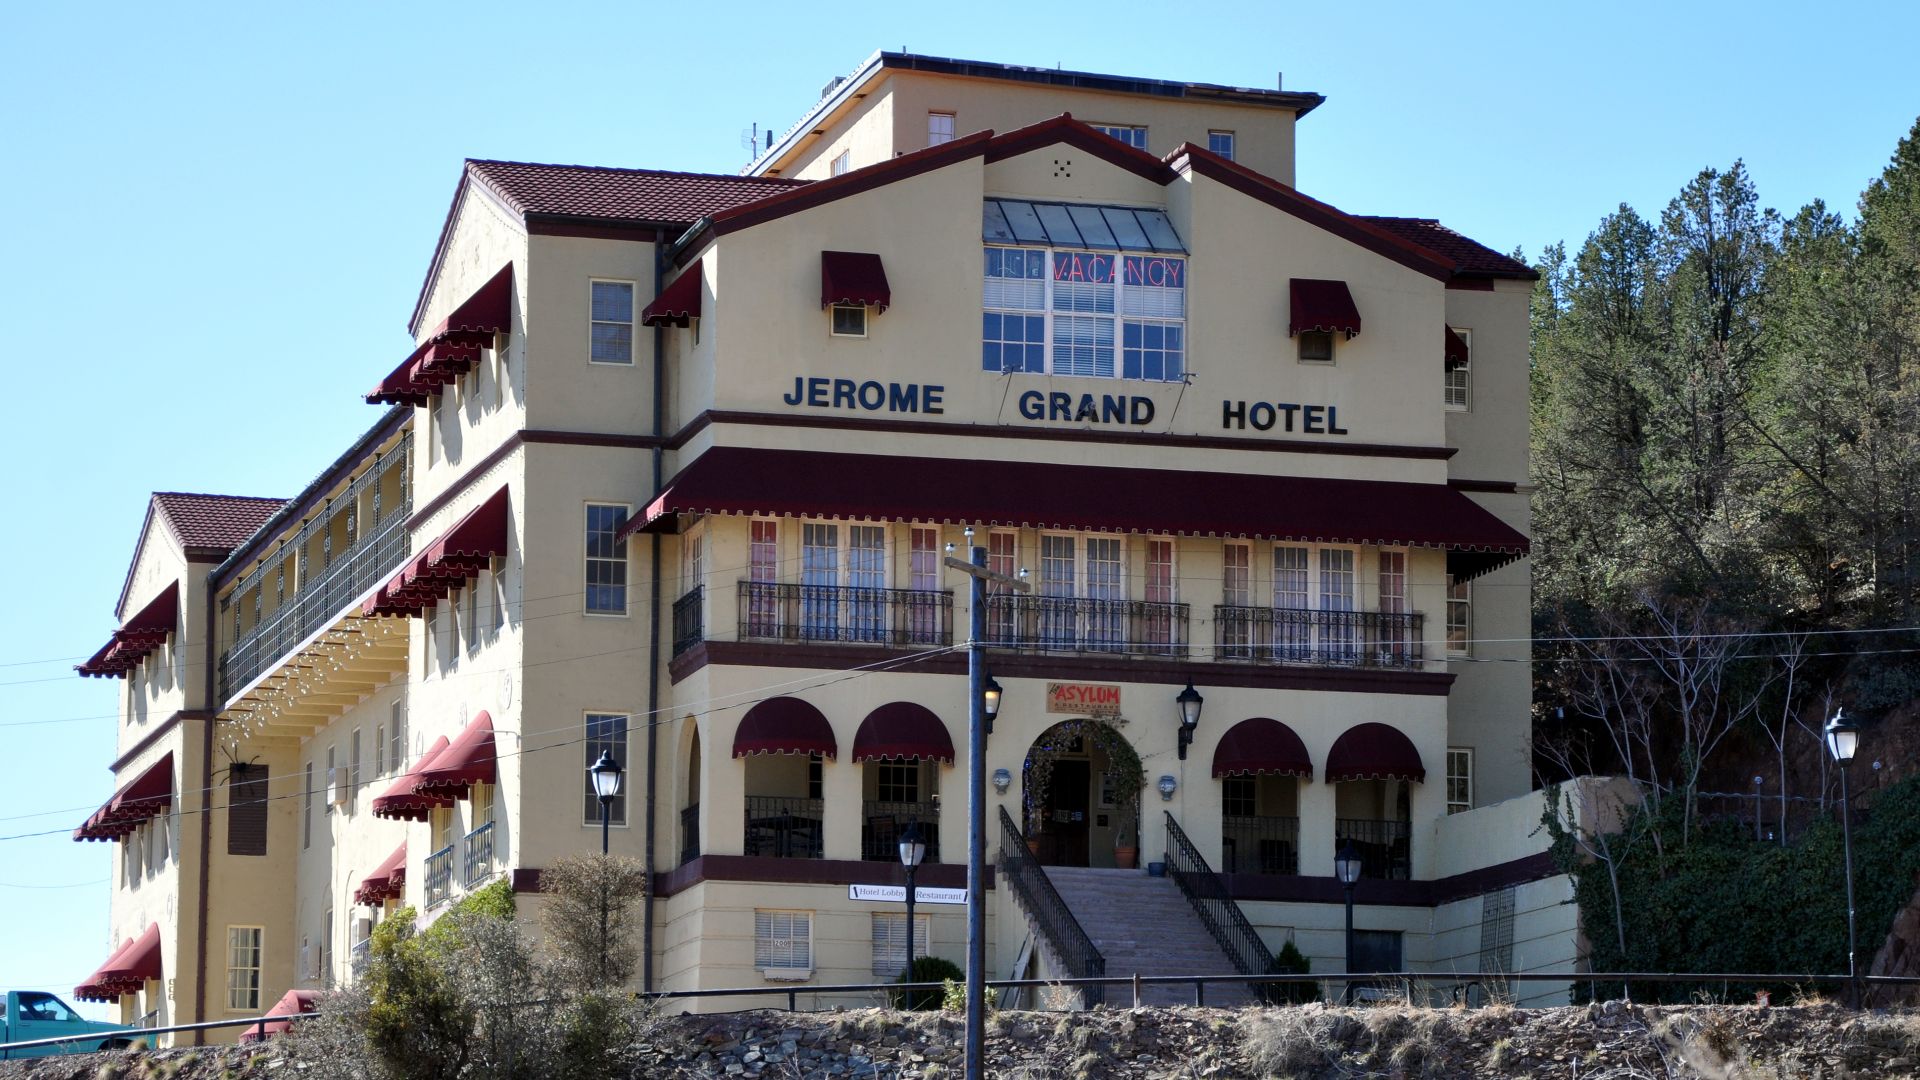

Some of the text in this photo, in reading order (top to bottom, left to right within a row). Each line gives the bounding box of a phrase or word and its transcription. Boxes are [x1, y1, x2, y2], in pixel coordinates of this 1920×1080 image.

[1052, 255, 1180, 286] VACANCY
[783, 376, 1348, 436] JEROME GRAND HOTEL
[1055, 685, 1119, 705] ASYLUM
[859, 888, 962, 901] Hotel Lobby Restaurant
